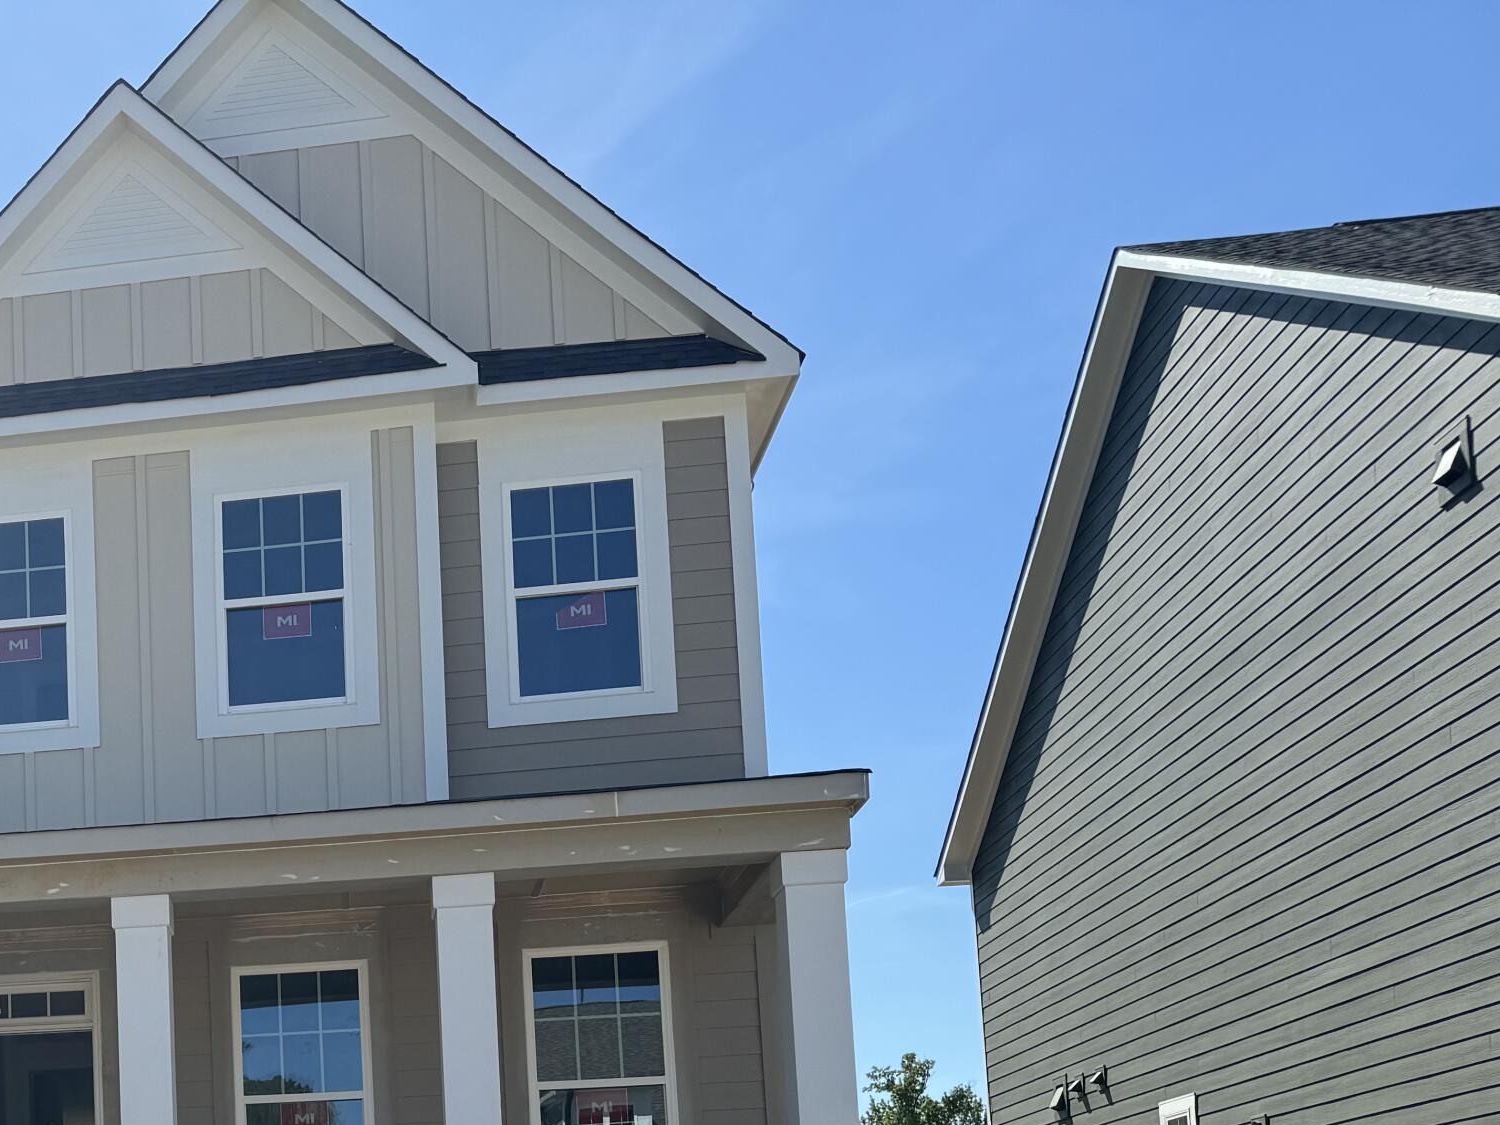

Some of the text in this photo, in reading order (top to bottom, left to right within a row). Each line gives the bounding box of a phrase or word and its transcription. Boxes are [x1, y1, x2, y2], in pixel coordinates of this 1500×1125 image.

[570, 604, 592, 617] MI
[276, 614, 298, 628] MI
[8, 638, 29, 652] MI
[591, 1101, 613, 1113] MI
[294, 1112, 315, 1125] MI
